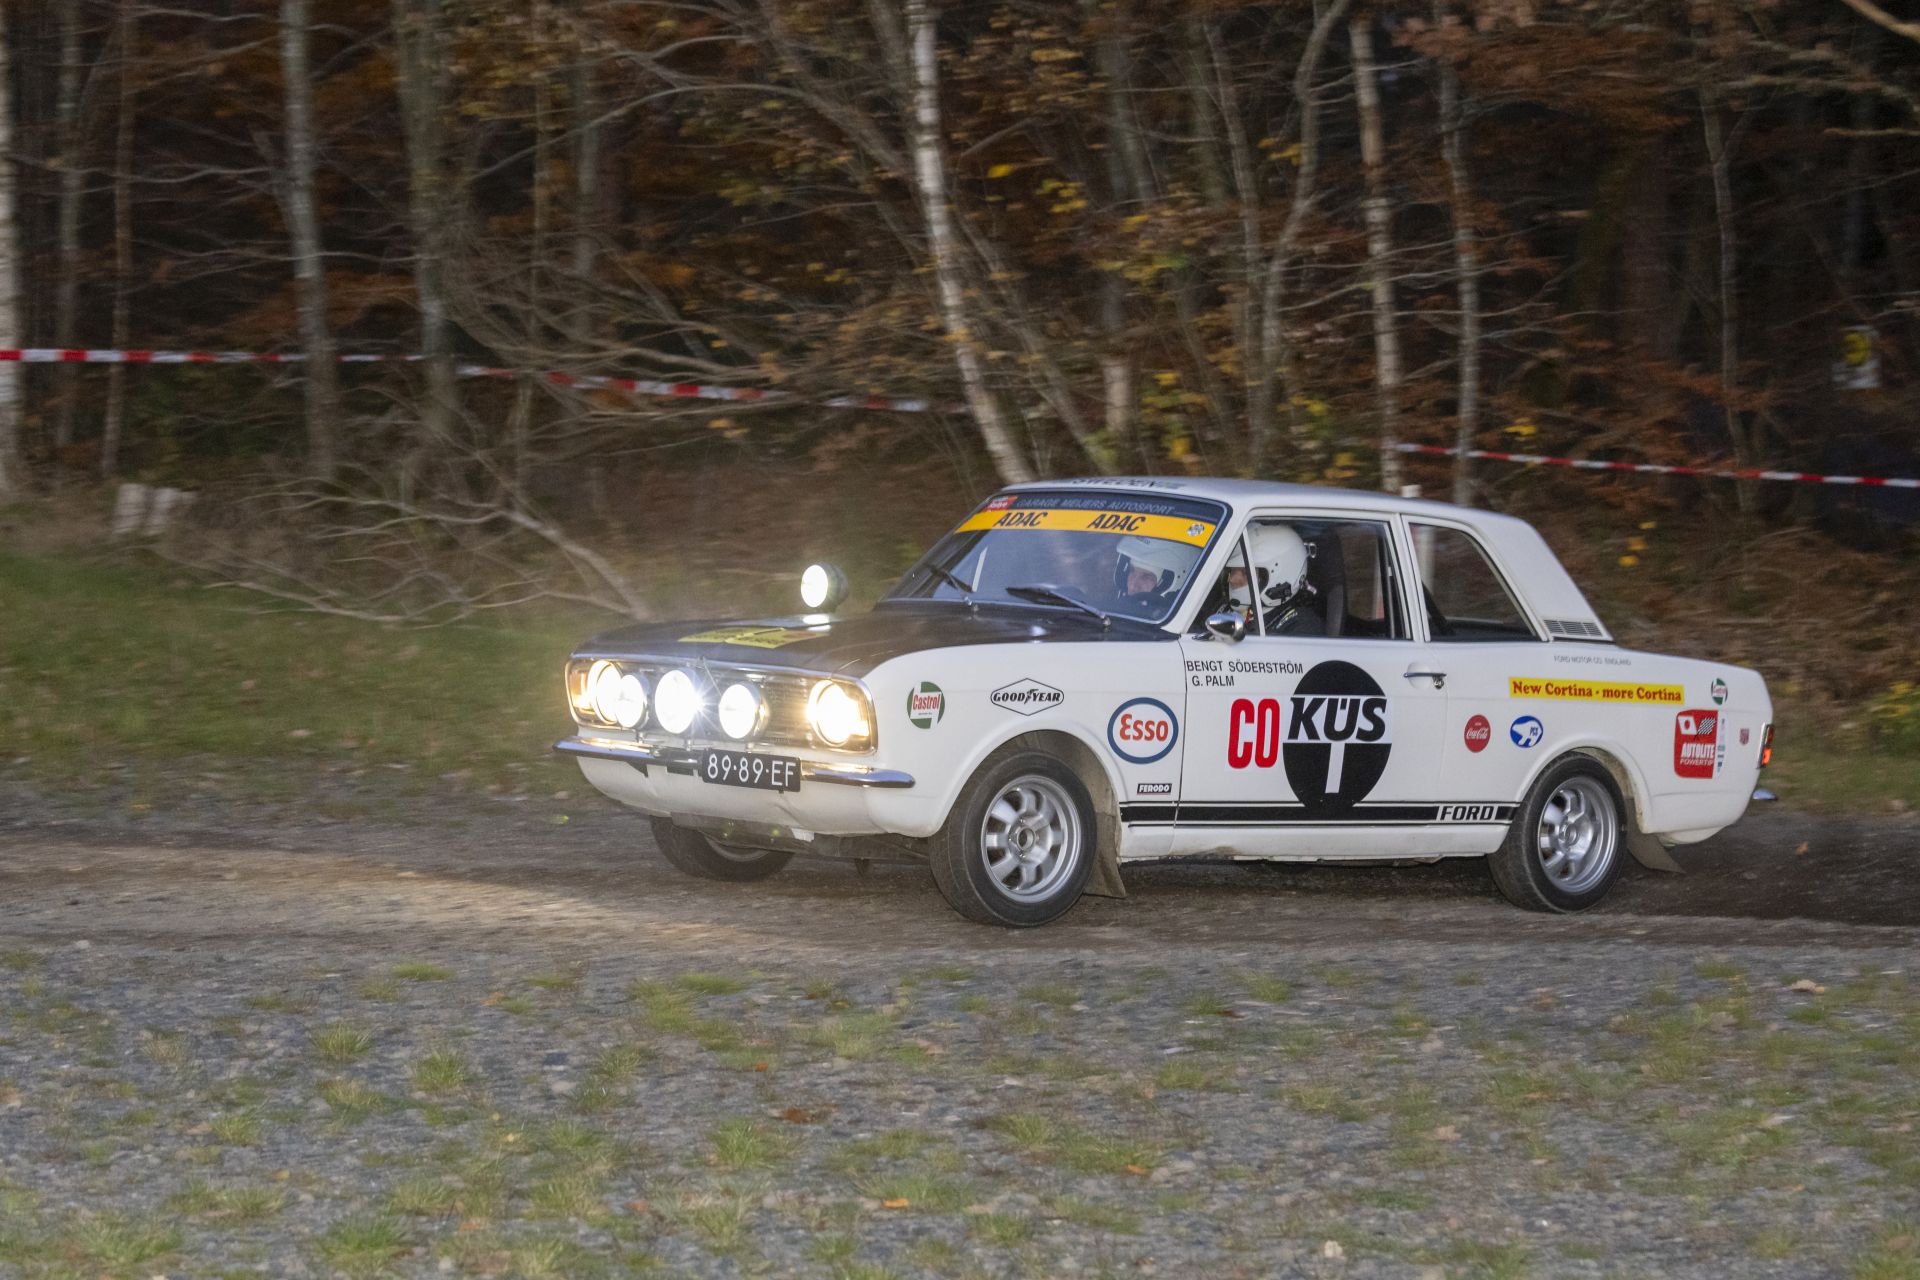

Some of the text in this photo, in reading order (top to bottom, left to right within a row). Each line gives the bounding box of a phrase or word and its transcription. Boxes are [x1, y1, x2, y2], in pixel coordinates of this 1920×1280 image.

[1109, 501, 1174, 515] AUTOSPORT
[993, 512, 1147, 532] ADAC ADAC
[1186, 659, 1304, 674] BENGT SÖDERSTRÖM
[1192, 675, 1235, 687] G. PALM
[1512, 680, 1542, 695] New
[1545, 682, 1593, 698] Cortina
[1602, 686, 1633, 699] more
[1636, 687, 1682, 702] Cortina
[912, 694, 941, 710] Castrol
[1286, 697, 1388, 742] KÜS
[1227, 698, 1281, 769] CO
[1681, 742, 1715, 759] AUTOLITE
[1138, 783, 1170, 793] FERODO
[1440, 805, 1494, 821] FORD
